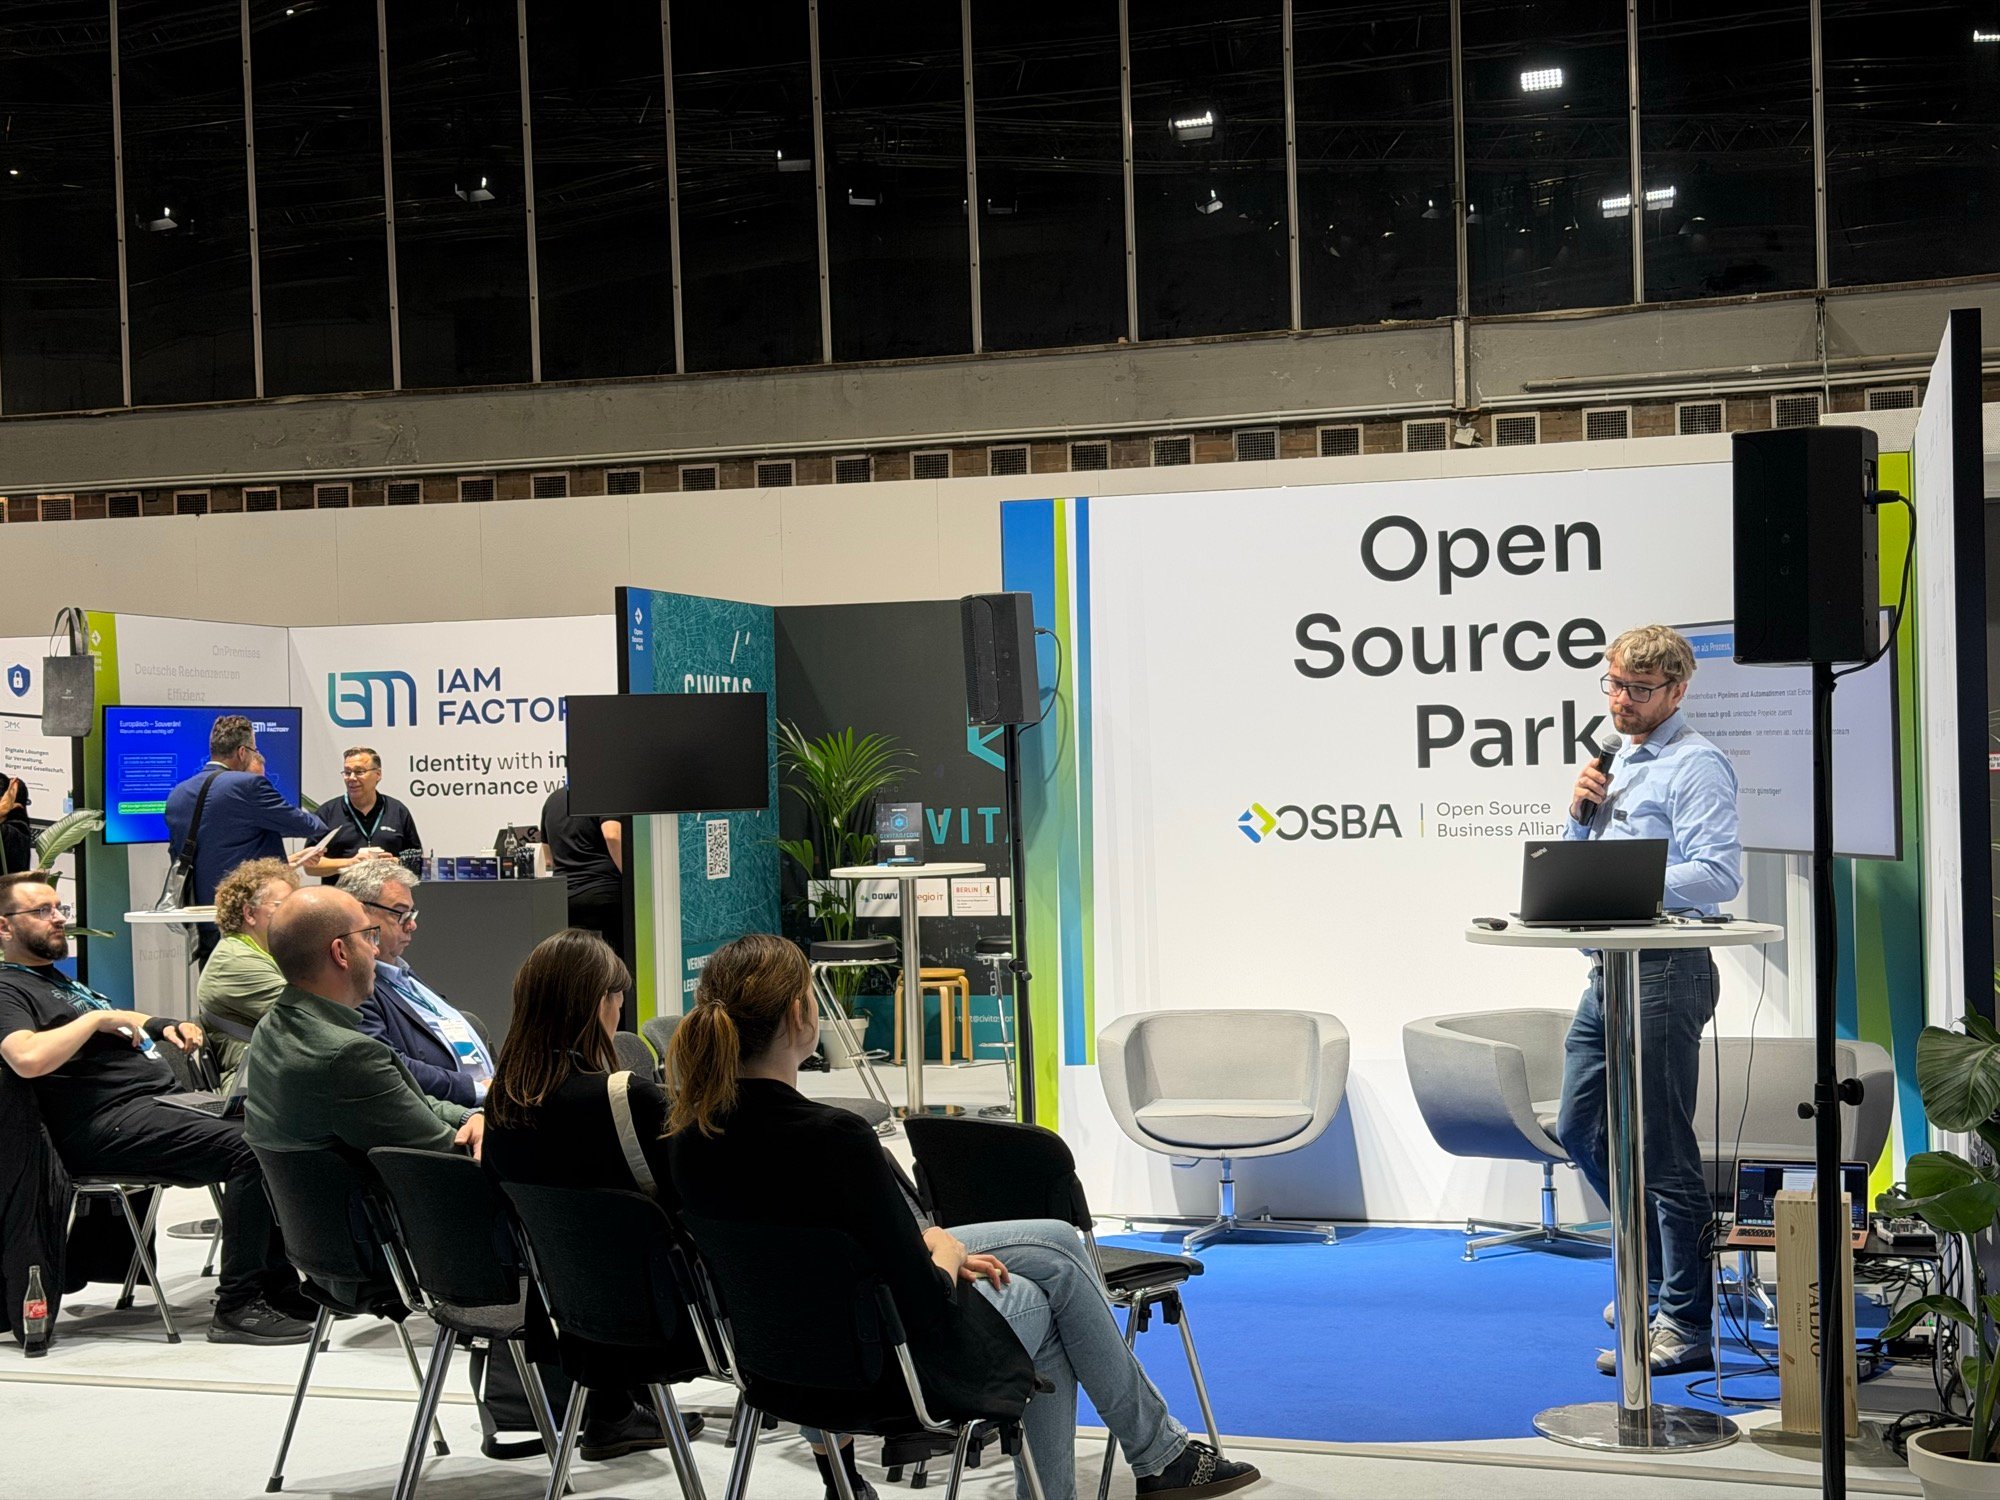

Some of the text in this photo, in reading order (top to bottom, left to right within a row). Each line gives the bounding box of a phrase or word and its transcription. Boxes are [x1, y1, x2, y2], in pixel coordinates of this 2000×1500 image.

[1361, 515, 1602, 596] Open
[212, 644, 261, 659] OnPremises
[1294, 612, 1606, 679] Source
[134, 663, 241, 680] Deutsche Rechenzentren
[438, 667, 501, 693] IAM
[167, 688, 206, 702] Effizienz
[439, 697, 566, 726] FACTO
[1417, 700, 1606, 769] Park
[410, 750, 567, 775] Identity with in
[410, 777, 567, 798] Governance wi
[1436, 799, 1551, 816] Open Source
[925, 806, 1008, 845] VIT
[1437, 820, 1565, 838] Business Allian
[956, 885, 979, 895] BERLIN
[687, 954, 710, 971] VERNE
